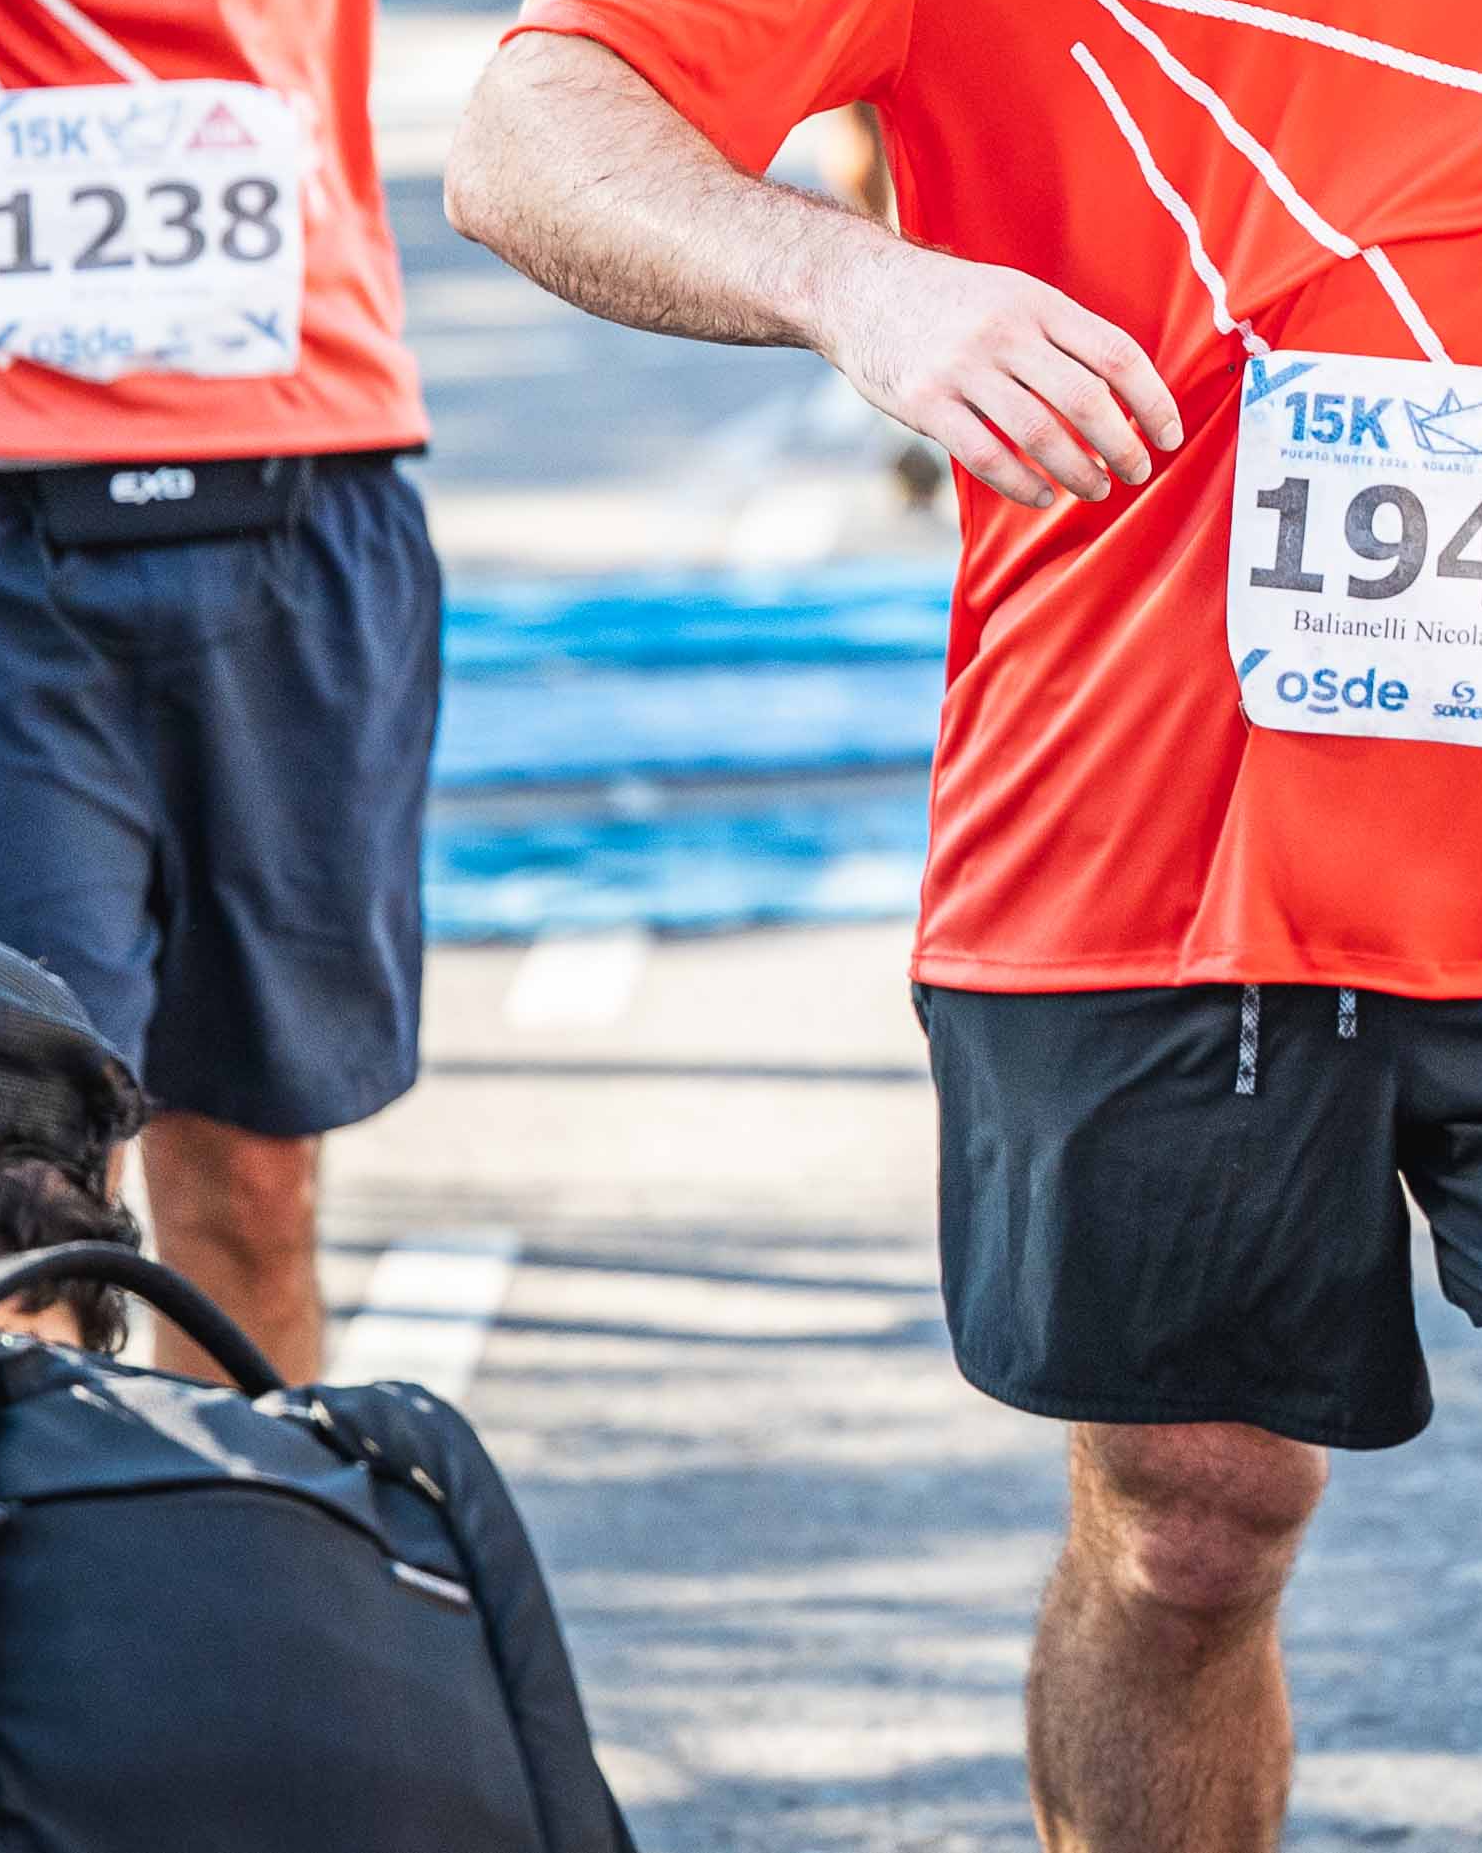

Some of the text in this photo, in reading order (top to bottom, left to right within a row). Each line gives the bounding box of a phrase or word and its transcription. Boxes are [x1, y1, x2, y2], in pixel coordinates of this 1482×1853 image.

[6, 114, 90, 158] 15K
[1285, 391, 1394, 451] 15K
[1294, 609, 1407, 641] Balianelli
[1276, 667, 1410, 714] osde
